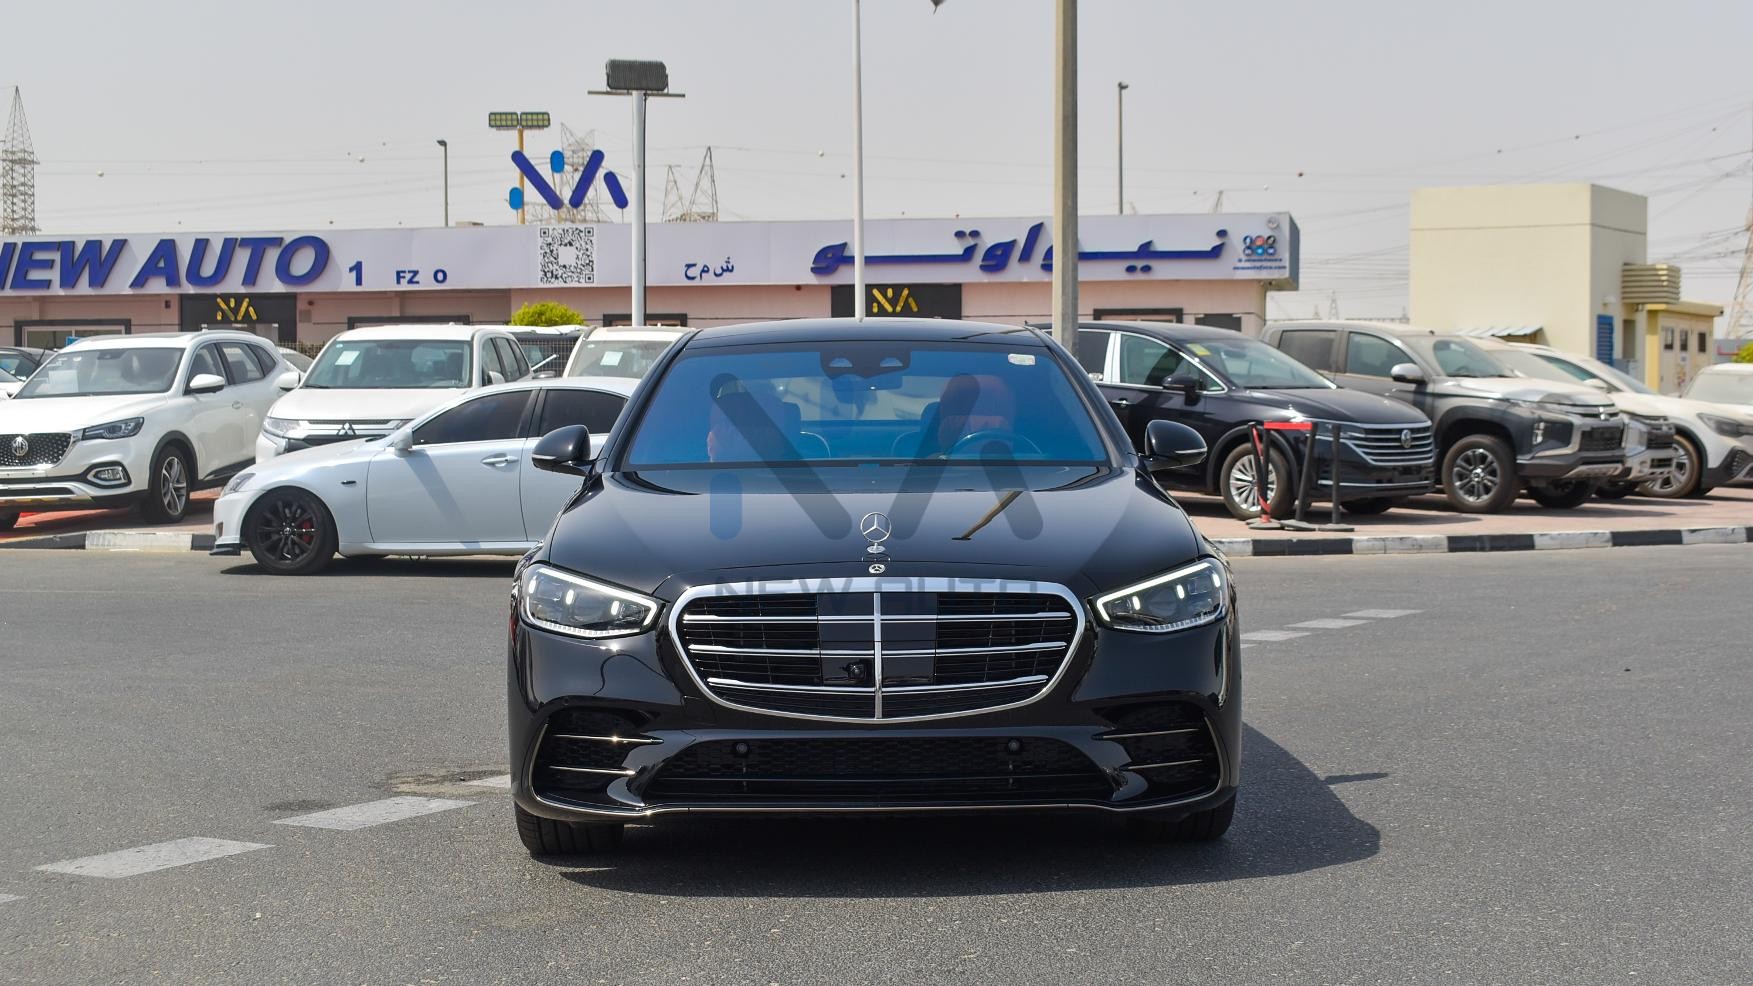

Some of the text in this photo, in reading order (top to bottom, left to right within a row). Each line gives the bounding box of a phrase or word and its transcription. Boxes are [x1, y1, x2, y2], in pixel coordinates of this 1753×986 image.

[129, 235, 331, 288] AUTO
[348, 260, 363, 287] 1
[395, 269, 420, 285] FZ
